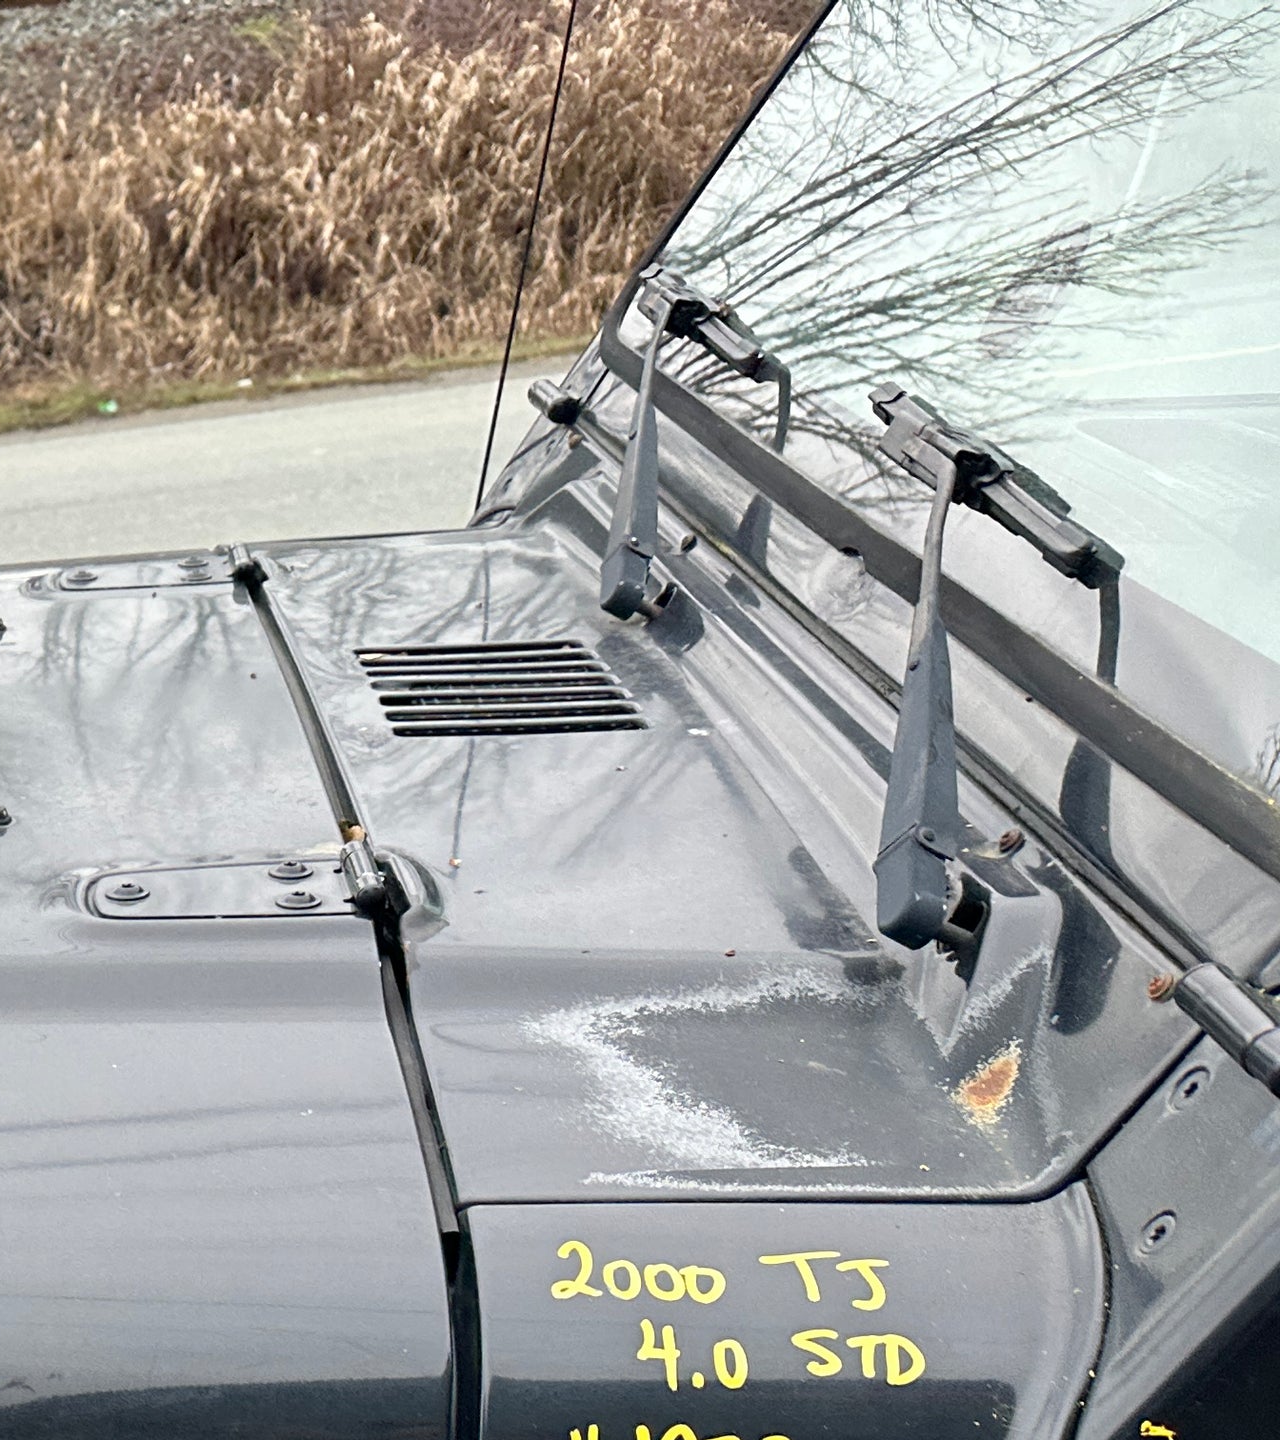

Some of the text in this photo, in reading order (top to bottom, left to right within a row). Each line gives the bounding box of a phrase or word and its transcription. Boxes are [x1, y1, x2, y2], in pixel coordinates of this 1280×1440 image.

[552, 1240, 890, 1311] 2000 TJ
[637, 1318, 926, 1391] 4.0 STD
